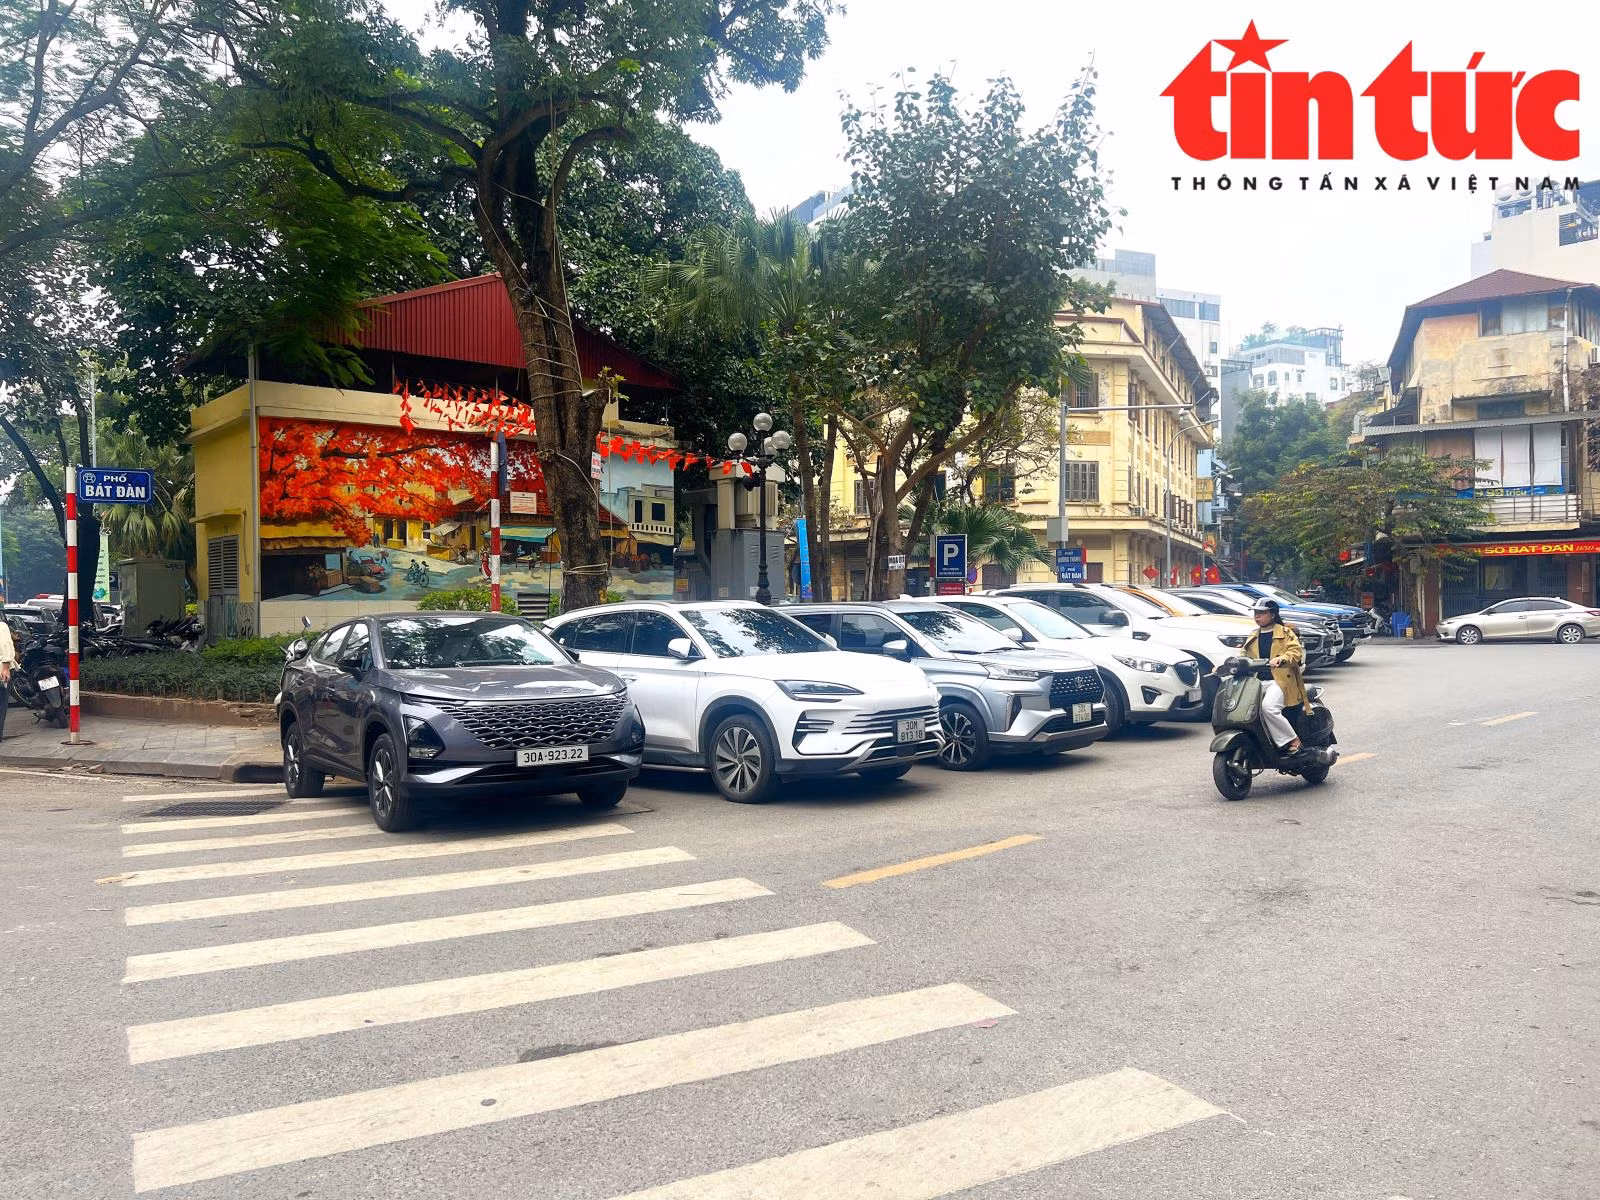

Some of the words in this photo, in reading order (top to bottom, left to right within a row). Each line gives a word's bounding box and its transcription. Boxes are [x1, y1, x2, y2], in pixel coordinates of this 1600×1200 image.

[103, 473, 127, 482] PHỐ
[85, 483, 113, 498] BÁT
[116, 484, 146, 499] ĐÀN
[943, 543, 959, 566] P
[905, 720, 918, 730] 30M
[523, 748, 583, 763] 30A-923.22
